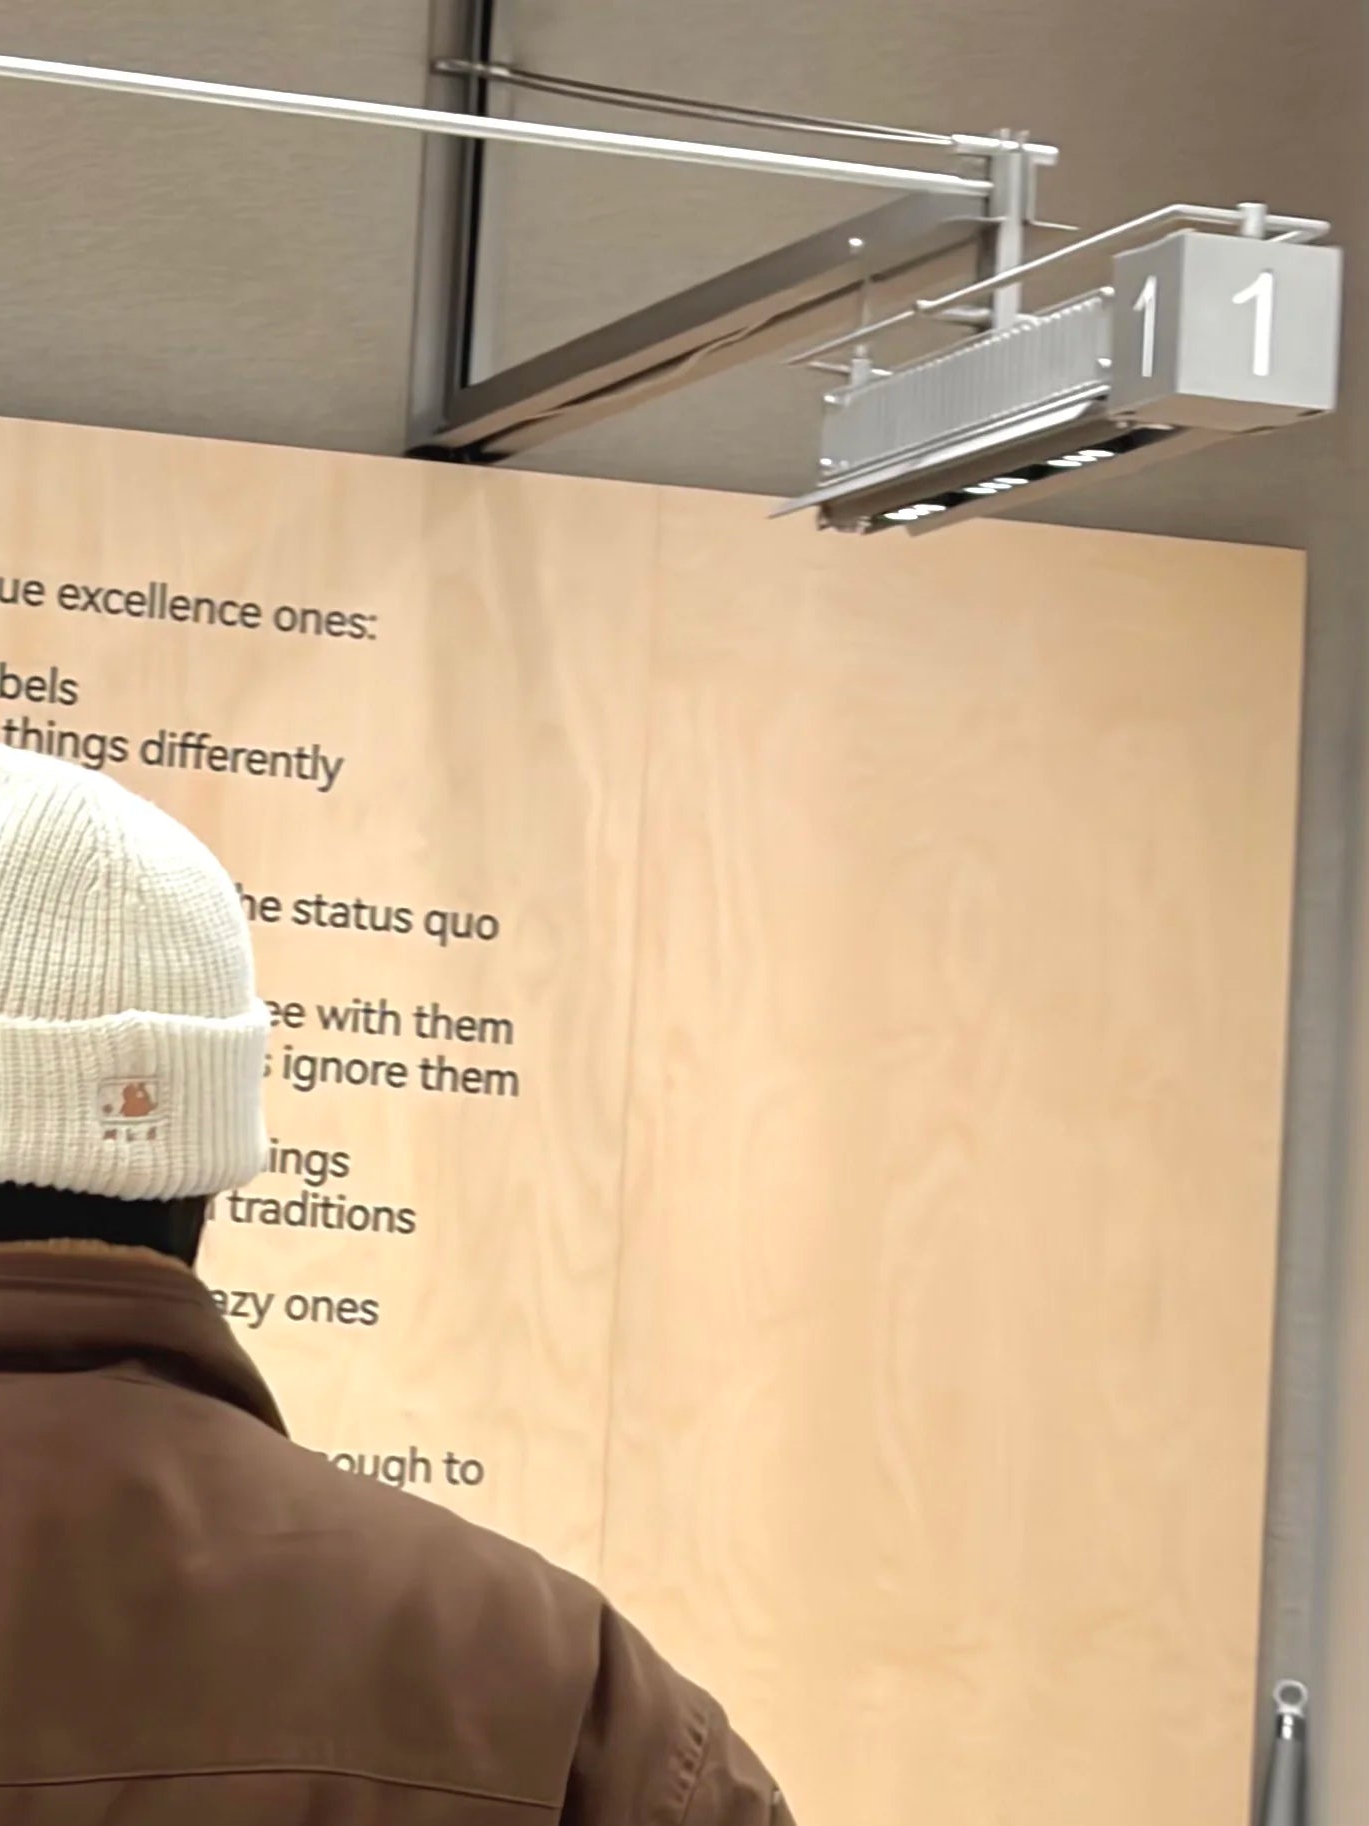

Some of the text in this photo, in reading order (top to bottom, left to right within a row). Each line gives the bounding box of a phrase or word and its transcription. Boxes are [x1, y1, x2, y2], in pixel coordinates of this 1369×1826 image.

[1132, 274, 1158, 377] 1
[1232, 271, 1274, 377] 1
[56, 580, 263, 630] excellence
[272, 603, 379, 642] ones:
[2, 716, 130, 773] things
[139, 729, 345, 793] differently
[234, 882, 500, 947] he status quo
[316, 997, 403, 1037] with
[413, 1001, 515, 1046] them
[281, 1043, 410, 1094] ignore
[418, 1054, 522, 1098] them
[268, 1136, 352, 1188] ings
[226, 1188, 418, 1235] traditions
[210, 1289, 381, 1330] azy ones
[331, 1445, 485, 1490] ough to
